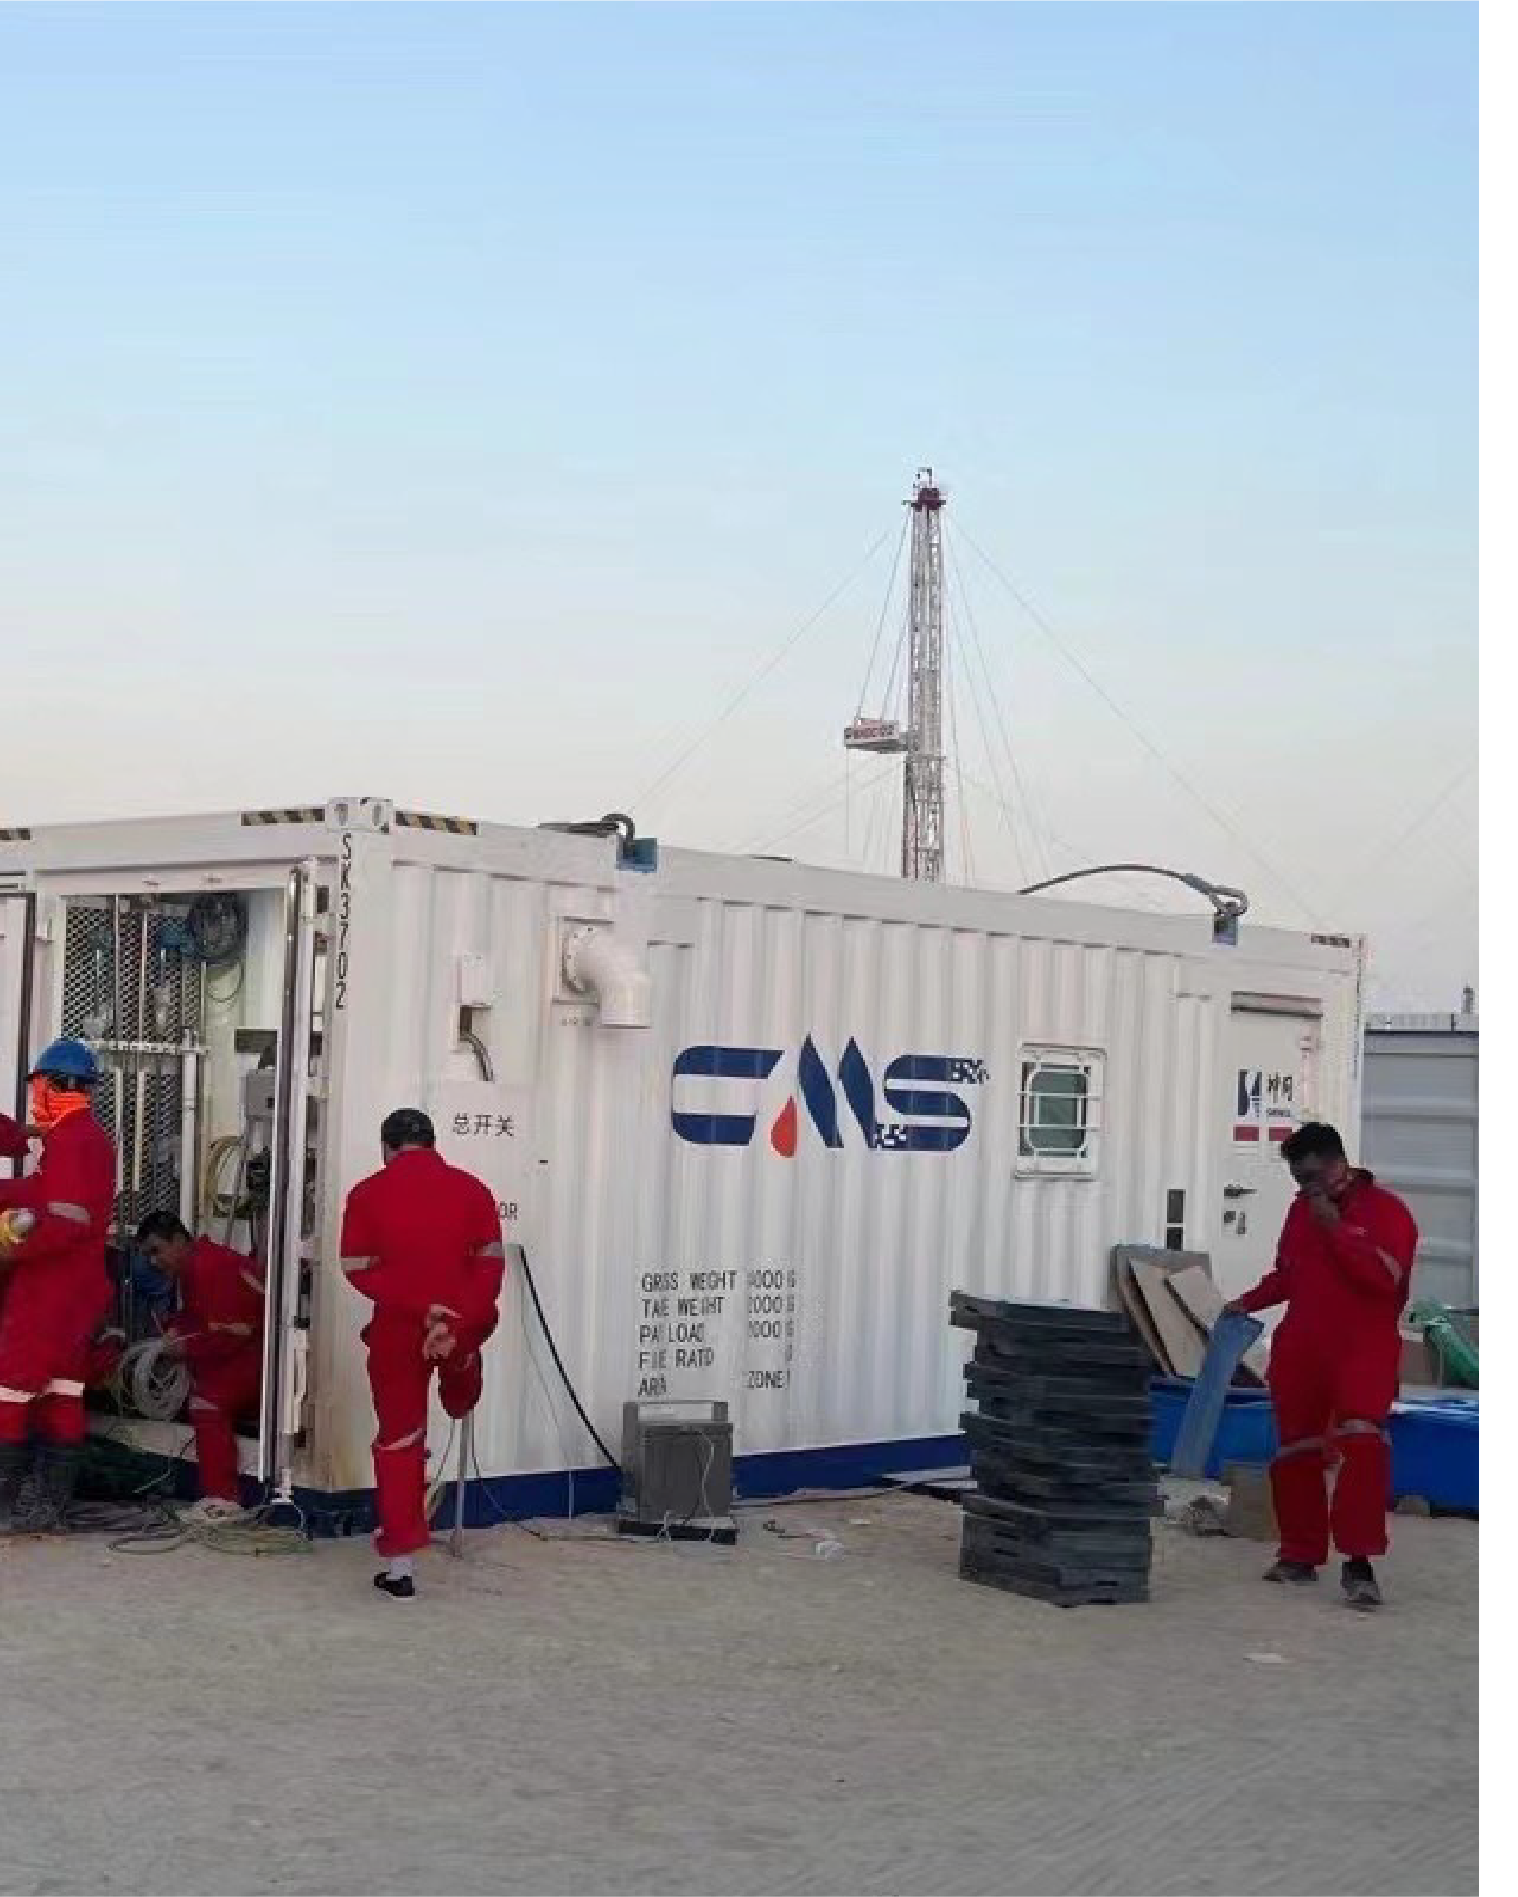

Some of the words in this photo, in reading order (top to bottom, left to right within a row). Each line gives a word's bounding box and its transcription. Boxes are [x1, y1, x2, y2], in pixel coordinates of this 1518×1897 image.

[335, 833, 351, 1010] SK3702
[452, 1112, 514, 1136] 总开关
